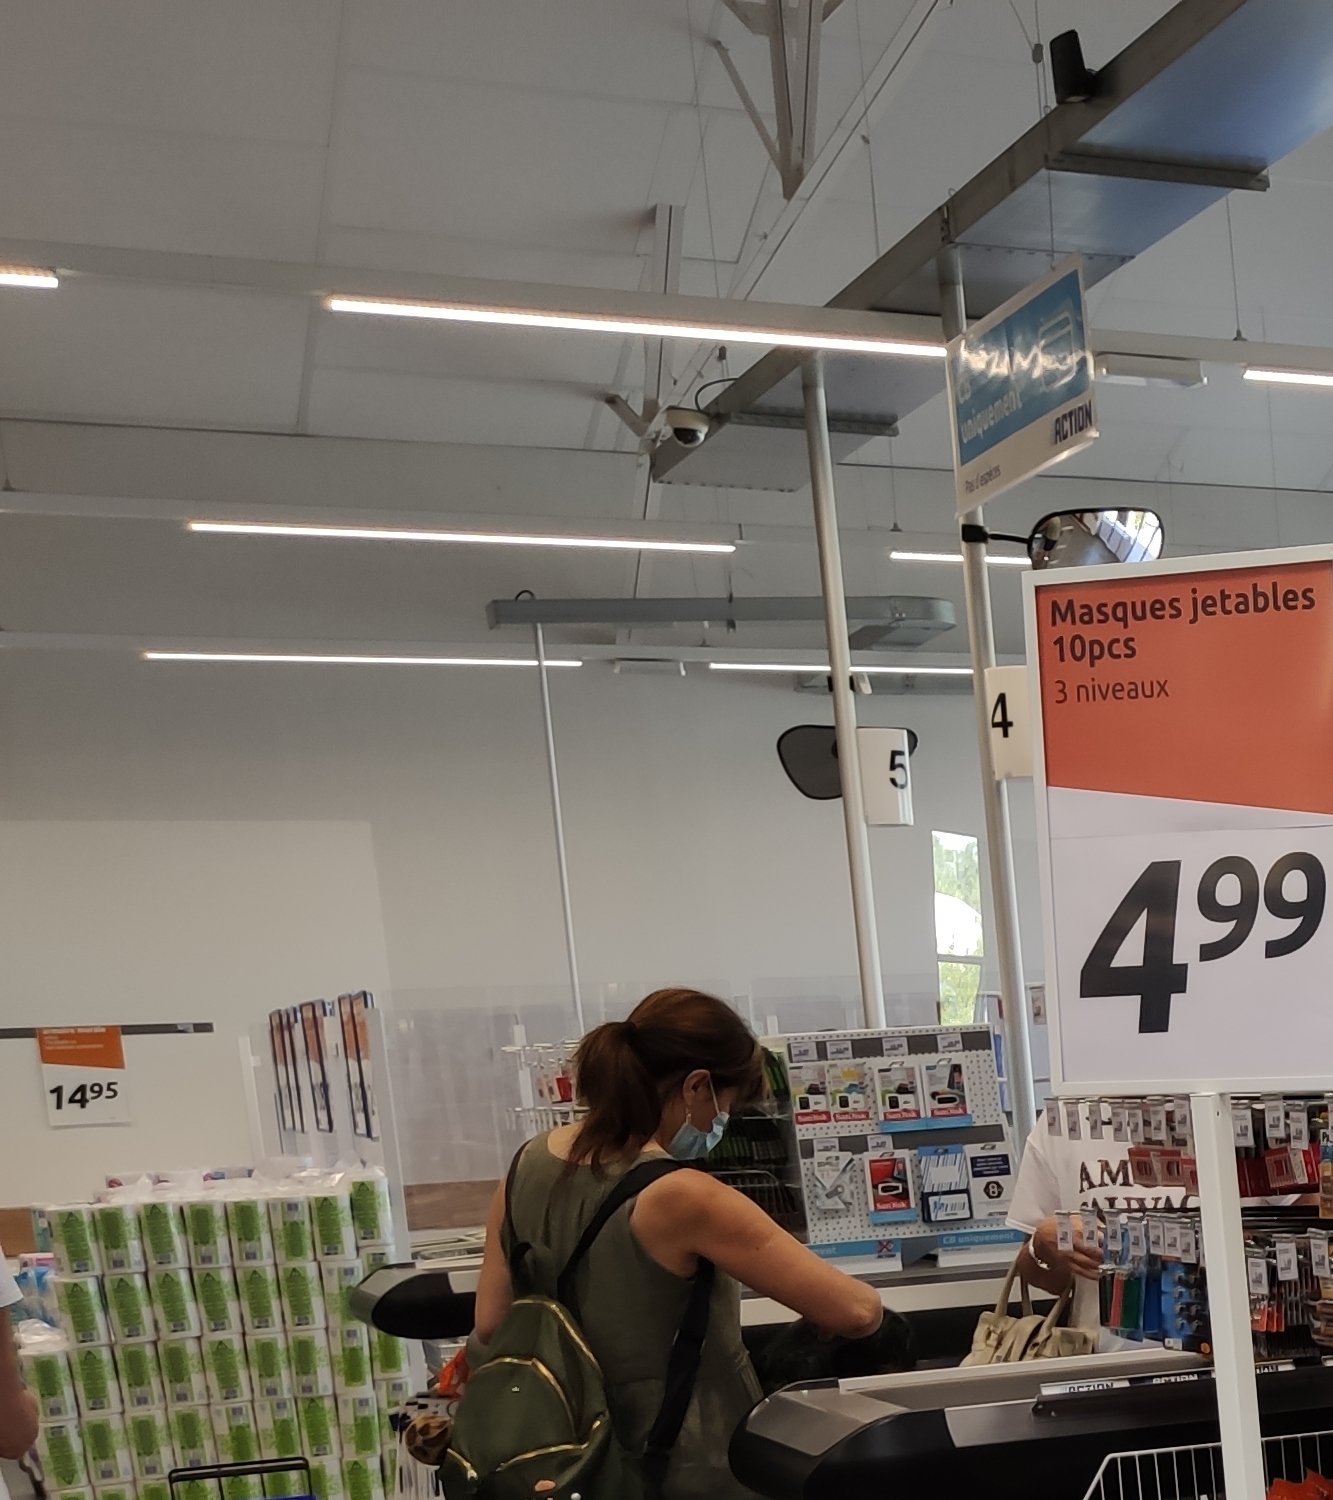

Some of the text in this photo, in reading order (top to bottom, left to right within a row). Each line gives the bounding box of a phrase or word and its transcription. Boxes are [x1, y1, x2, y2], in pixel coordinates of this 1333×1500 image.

[961, 389, 1023, 444] uniquement
[1053, 400, 1093, 444] ACTION
[1050, 582, 1316, 629] Masques jetables
[1053, 633, 1137, 667] 10pcs
[1054, 676, 1170, 703] 3 niveaux
[991, 693, 1013, 738] 4
[889, 750, 908, 789] 5
